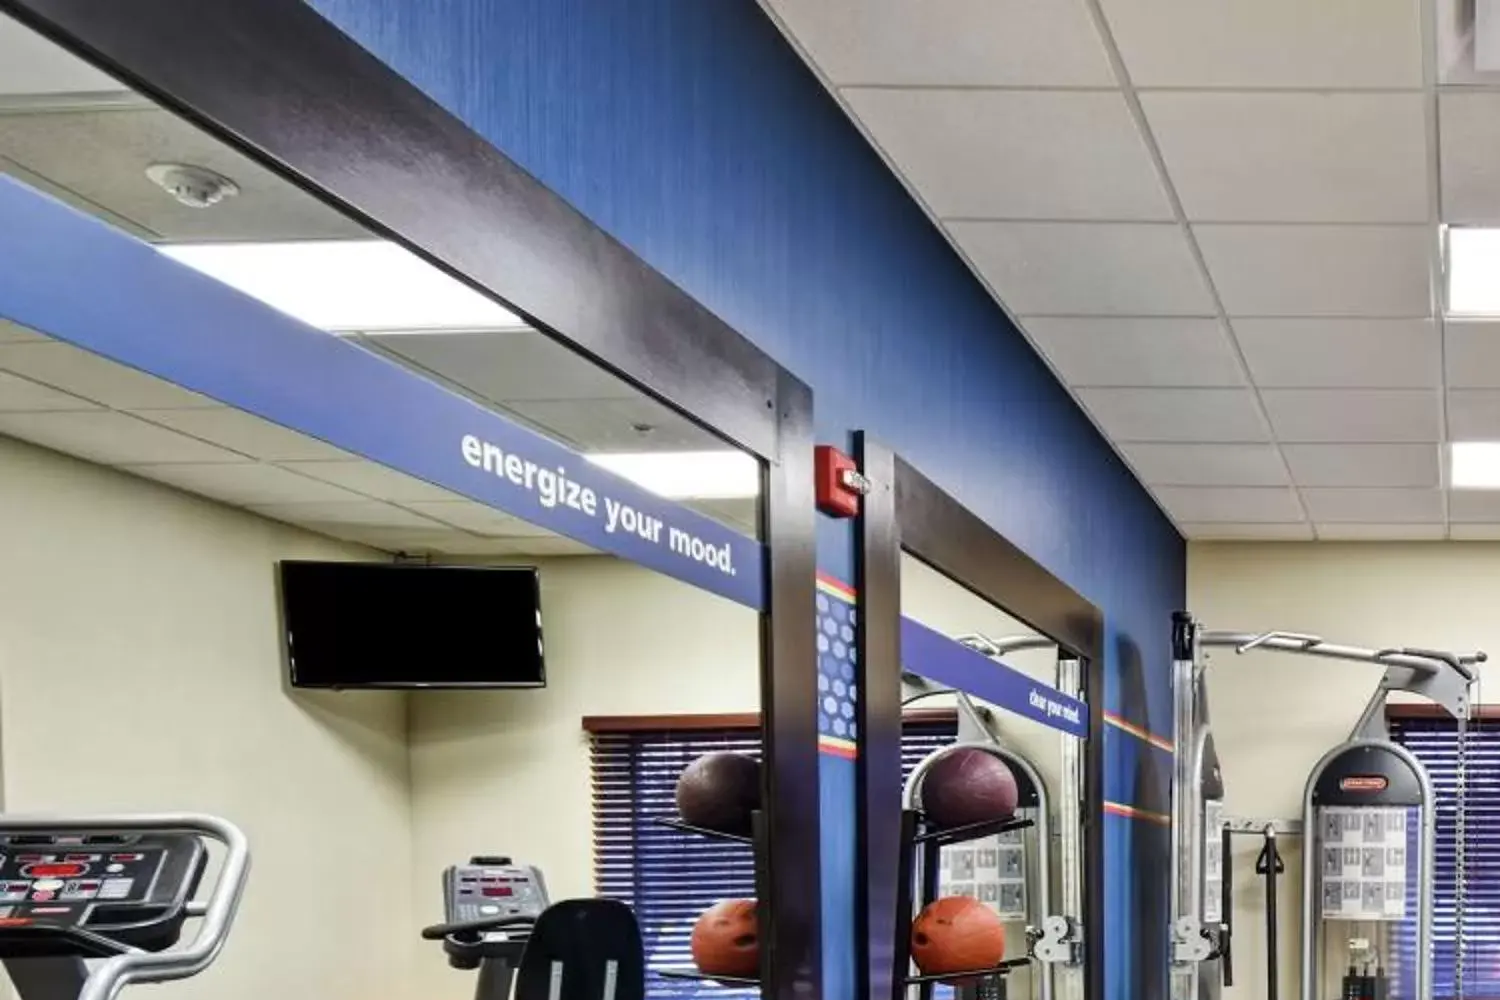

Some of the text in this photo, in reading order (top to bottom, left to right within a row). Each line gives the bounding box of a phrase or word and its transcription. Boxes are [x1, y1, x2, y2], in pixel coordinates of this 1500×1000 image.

[461, 434, 737, 577] energize your mood.
